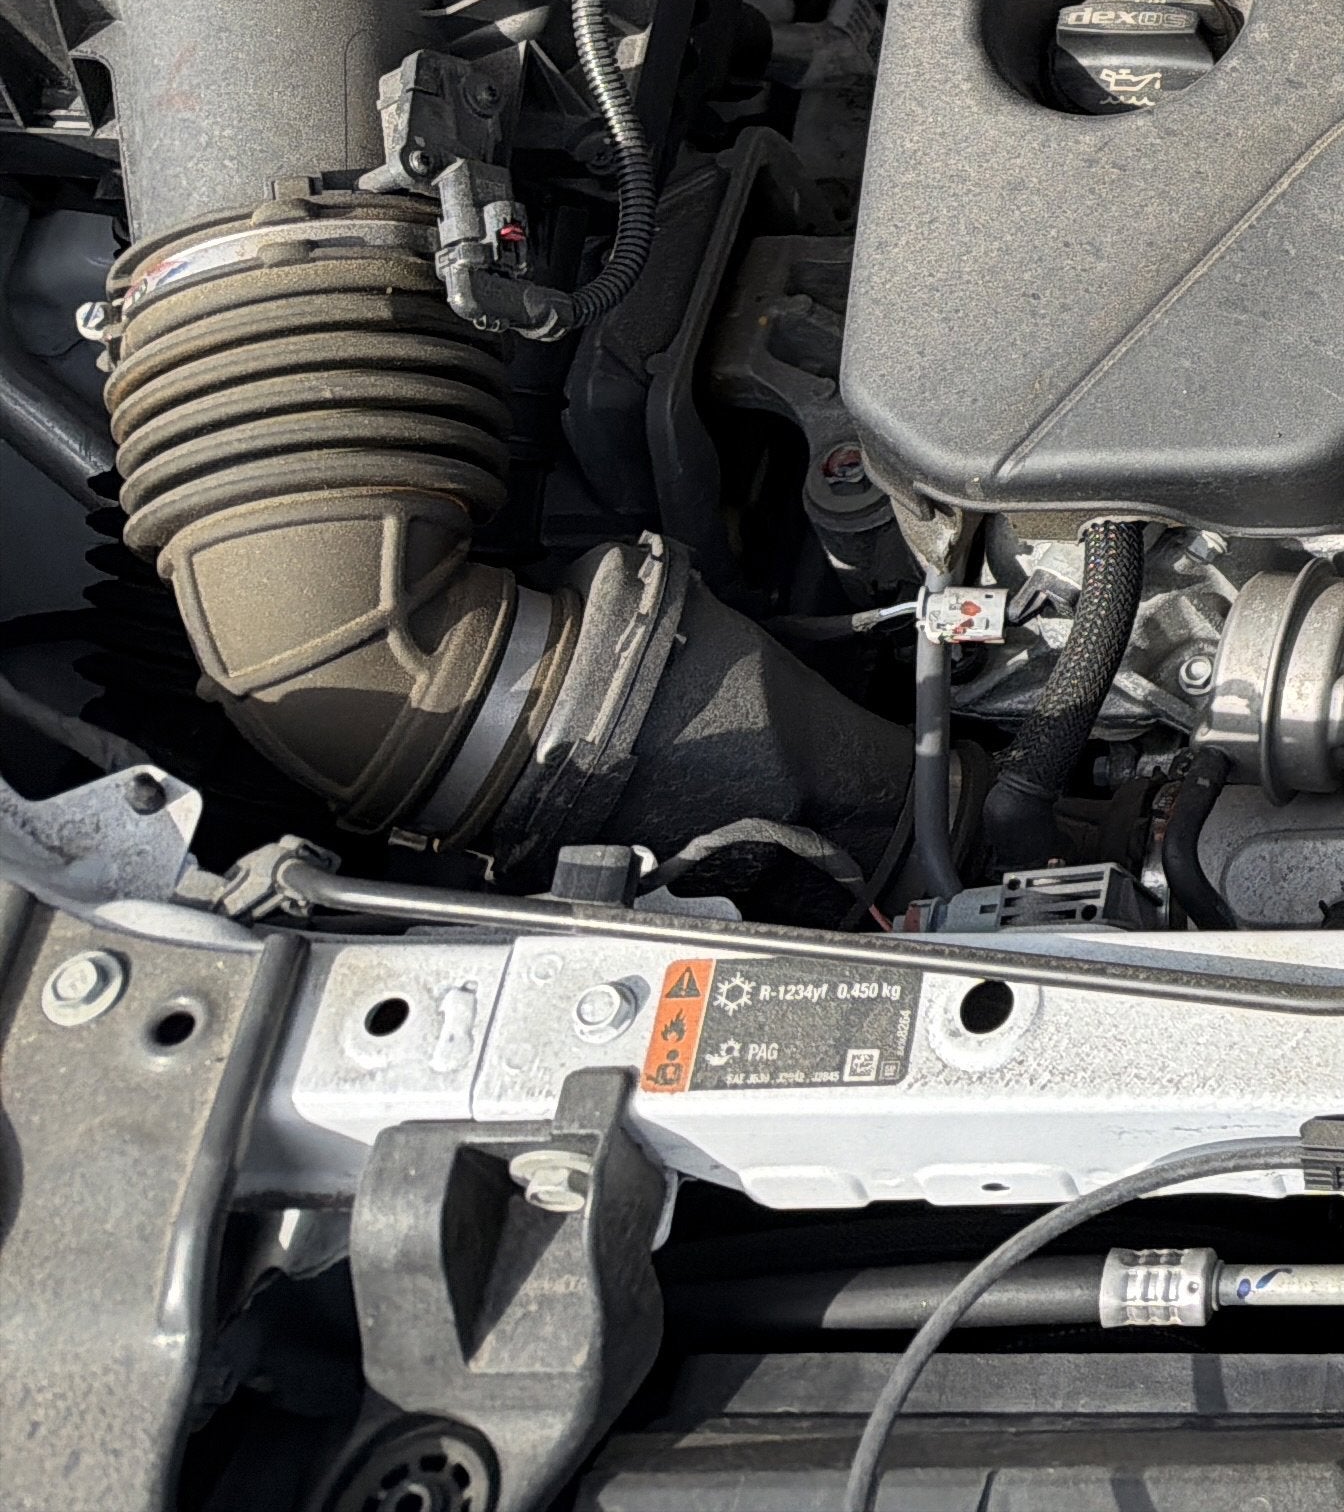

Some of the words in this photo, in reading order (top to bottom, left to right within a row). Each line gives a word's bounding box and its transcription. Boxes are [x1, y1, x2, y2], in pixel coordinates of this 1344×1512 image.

[1067, 7, 1189, 28] dexos
[759, 983, 827, 1003] R-1234yf
[836, 982, 879, 999] 0.450
[881, 982, 902, 1001] kg
[747, 1043, 779, 1061] PAG
